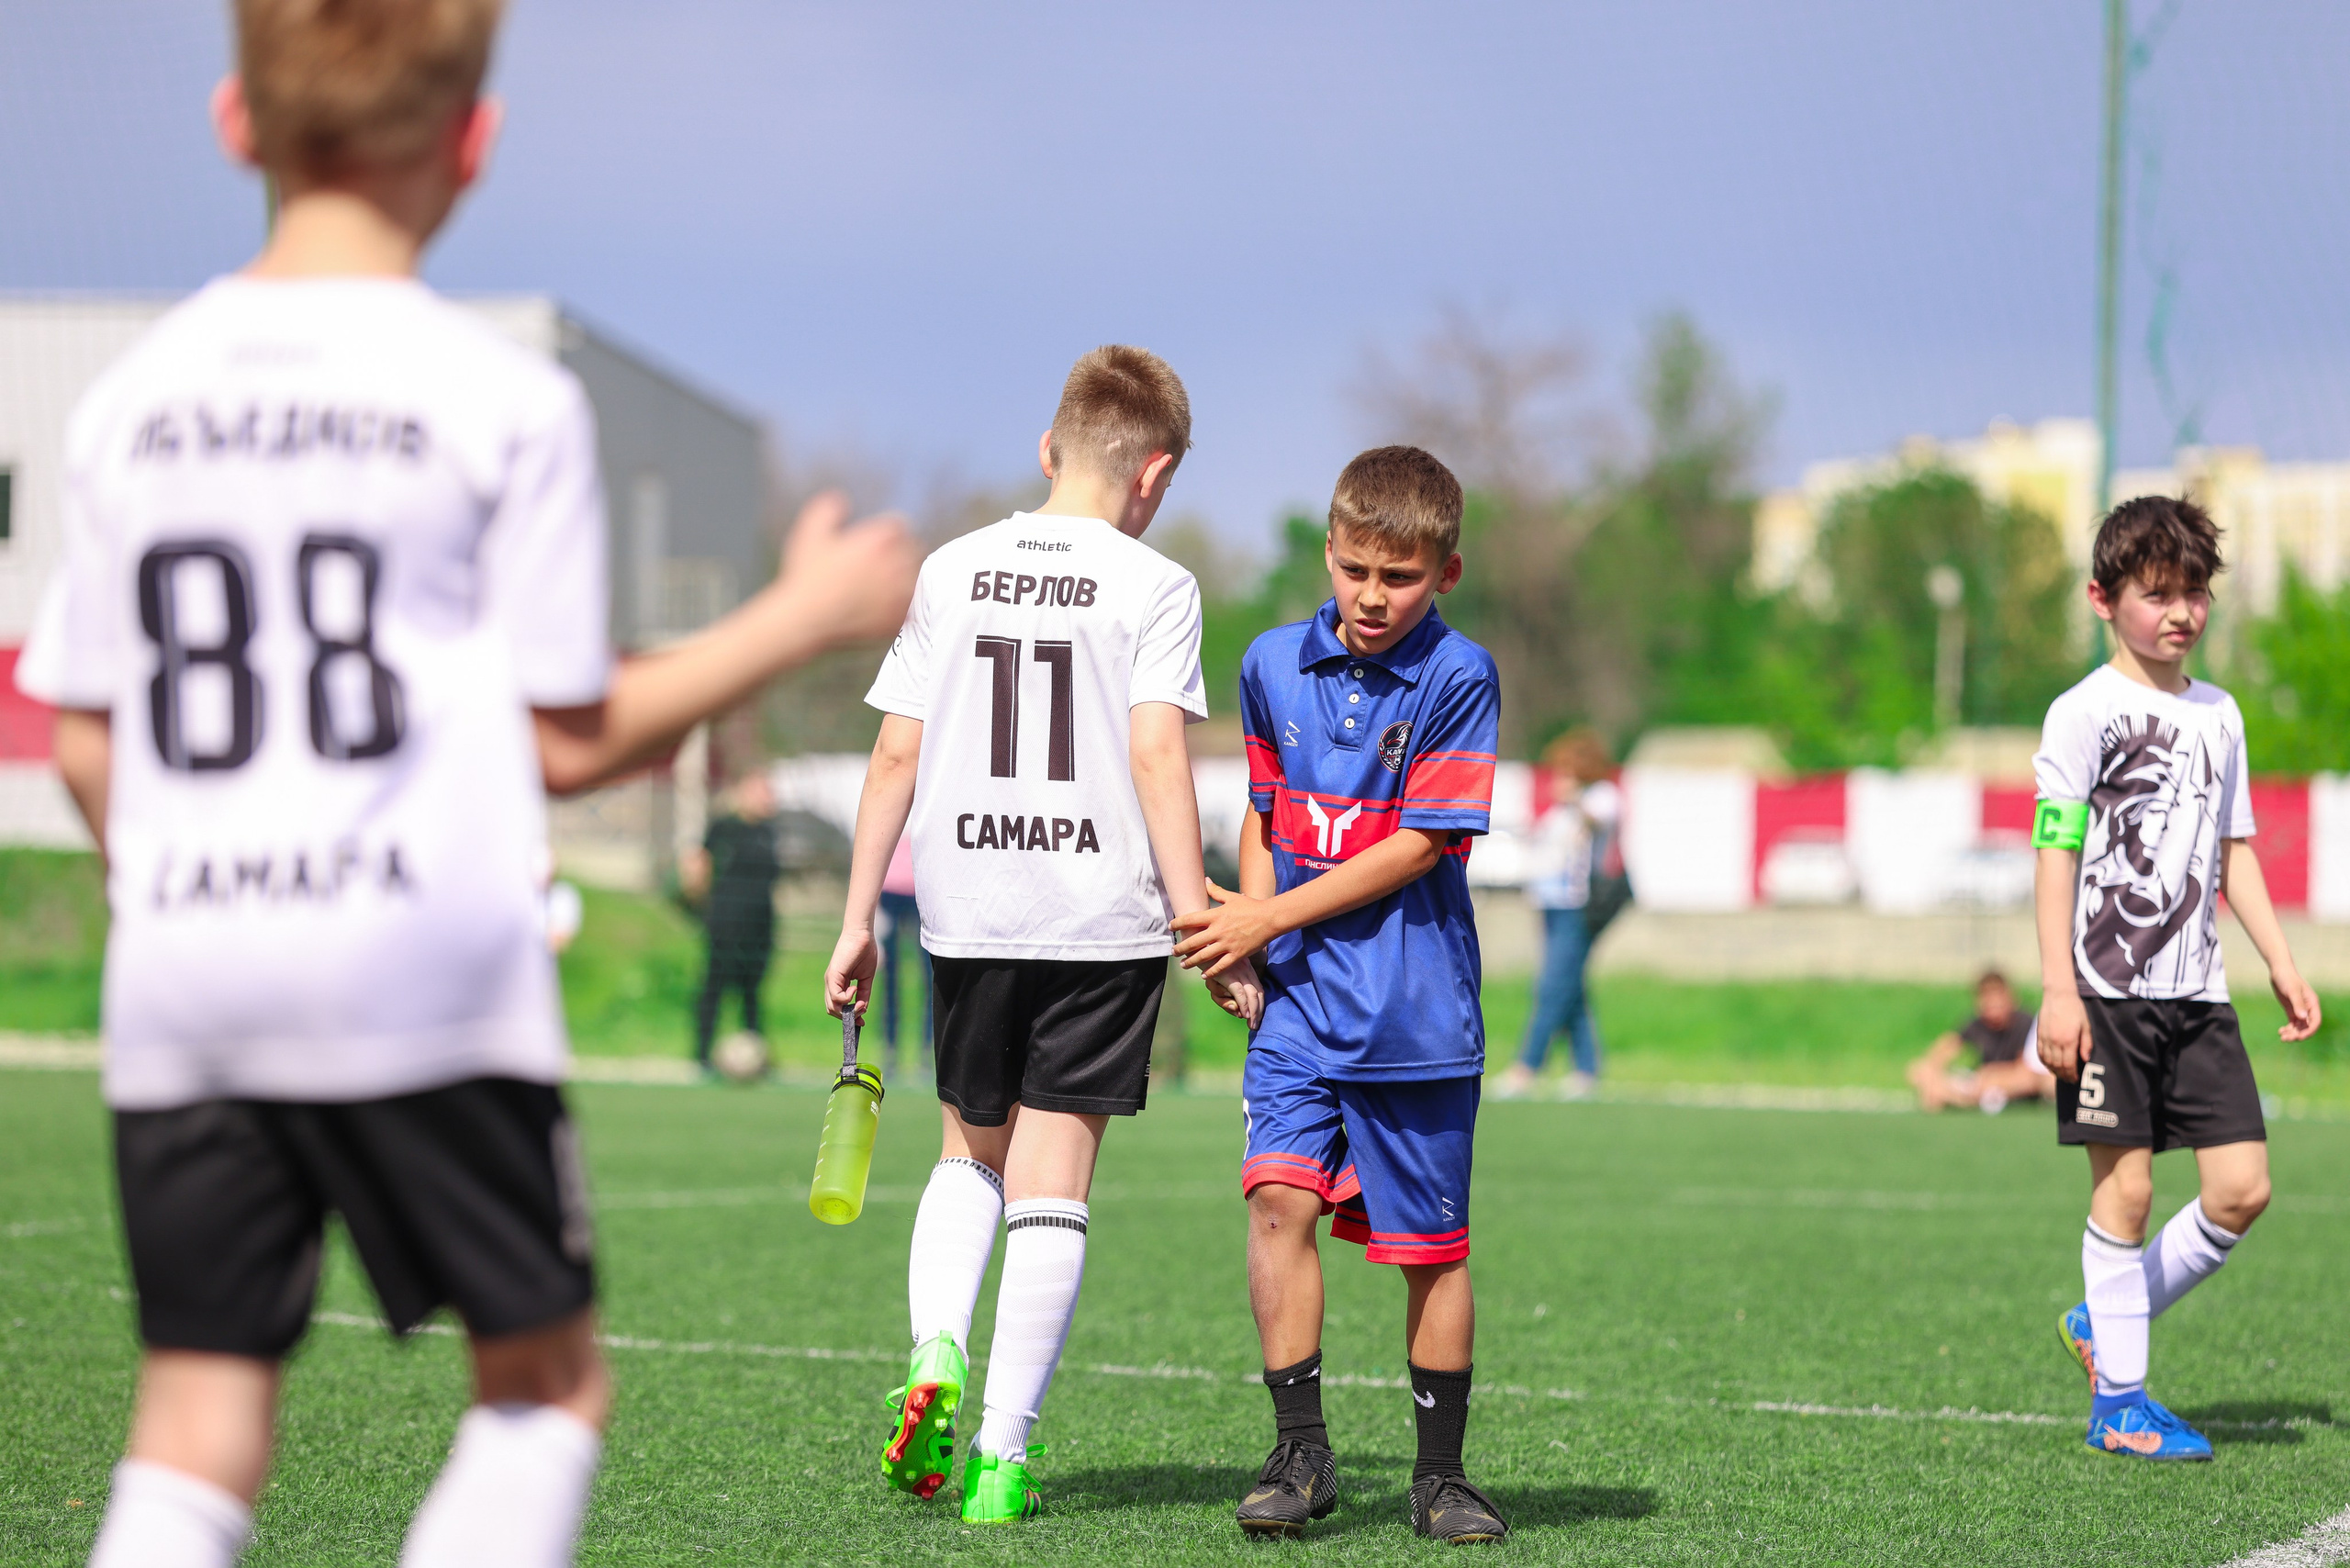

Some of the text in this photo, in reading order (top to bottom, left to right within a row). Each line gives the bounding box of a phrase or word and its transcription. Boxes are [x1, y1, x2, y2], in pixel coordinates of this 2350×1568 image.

[970, 570, 1098, 608] БЕРЛОВ
[139, 531, 408, 774] 88
[975, 634, 1075, 782] 11
[957, 813, 1101, 854] САМАРА
[2040, 808, 2061, 841] C
[2078, 1061, 2105, 1109] 5
